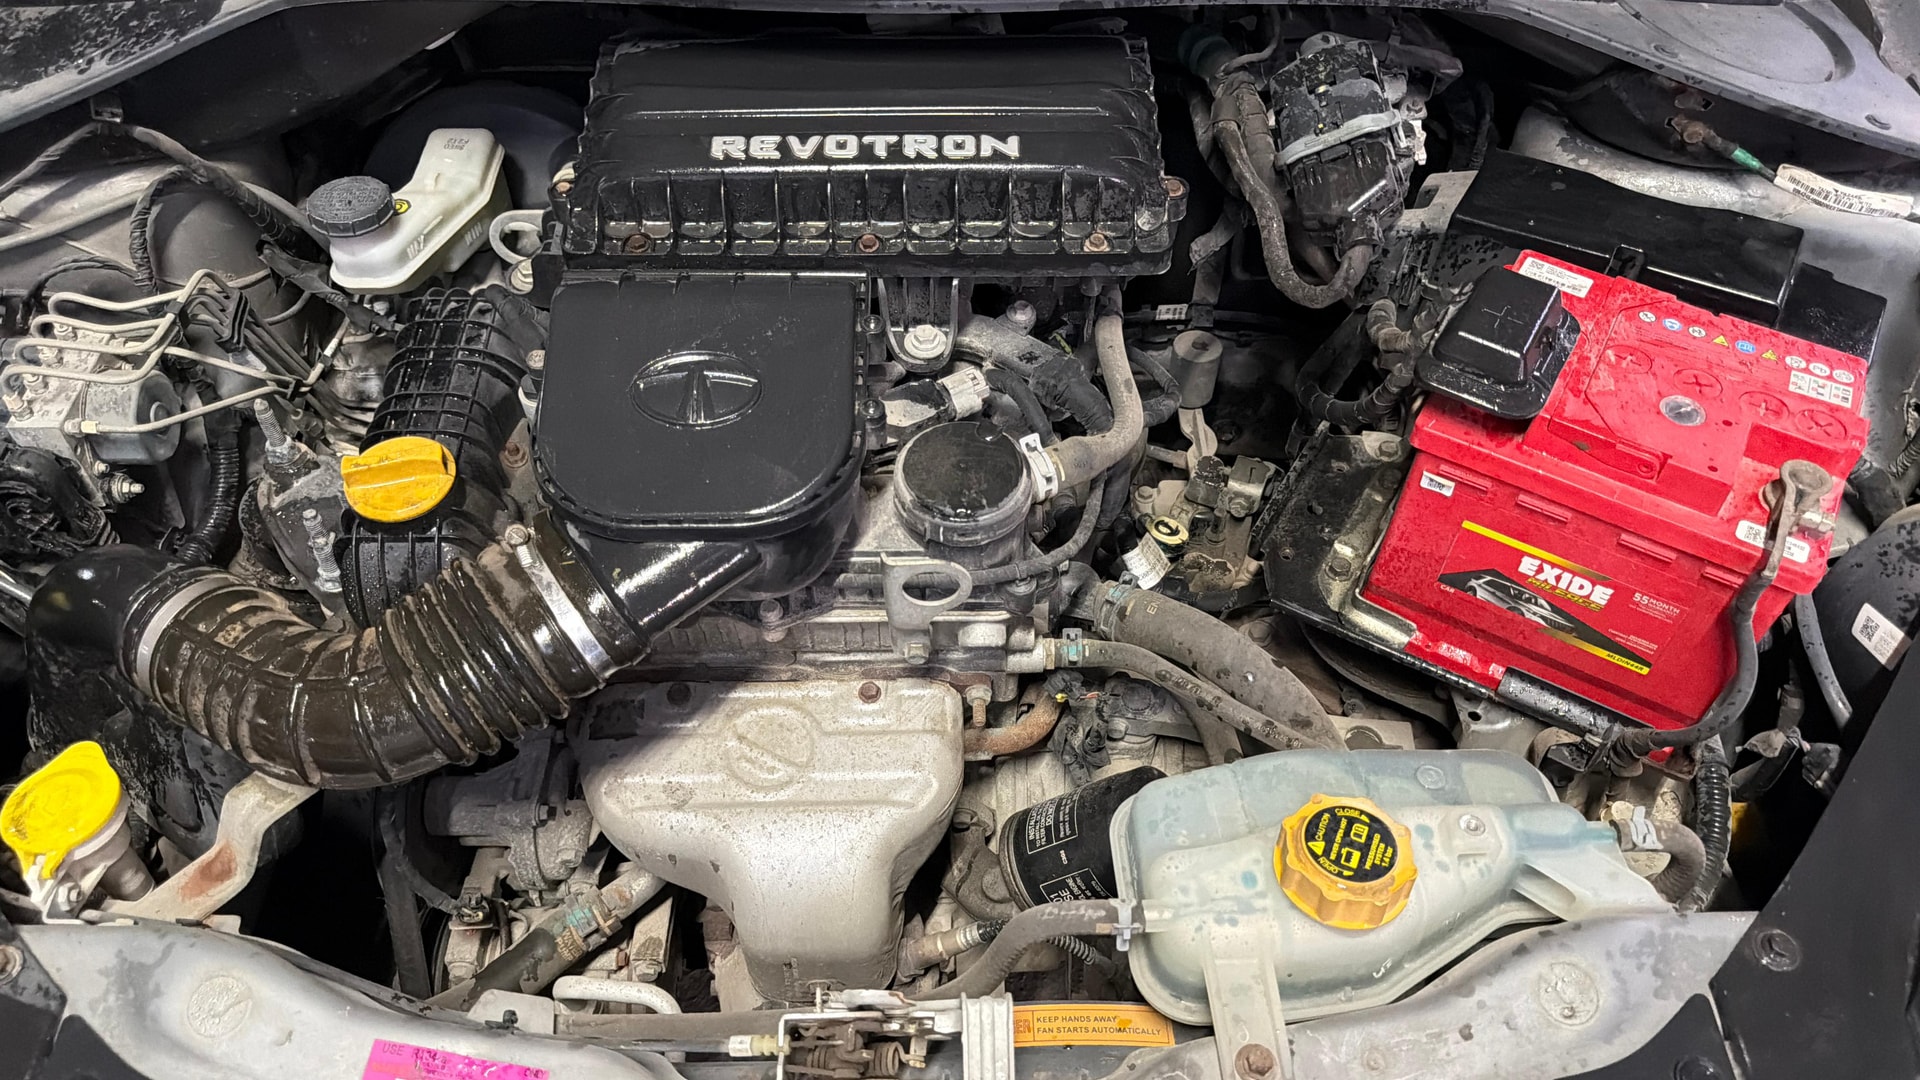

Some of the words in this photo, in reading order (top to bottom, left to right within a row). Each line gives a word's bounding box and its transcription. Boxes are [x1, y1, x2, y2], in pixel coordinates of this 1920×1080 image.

[710, 134, 1020, 160] REVOTRON
[464, 222, 483, 247] MIN
[1518, 555, 1615, 606] EXIDE
[1632, 592, 1650, 605] 55
[1649, 598, 1681, 615] MONTH
[1605, 652, 1644, 672] MLDIN44R
[1334, 807, 1361, 818] CLOSE
[1315, 812, 1331, 841] CAUTION
[1374, 842, 1386, 865] SYSTEM
[1384, 845, 1393, 857] bar
[1320, 856, 1338, 874] OPEN
[1381, 856, 1390, 867] 1.4
[1036, 1015, 1059, 1024] KEEP
[1061, 1015, 1092, 1023] HANDS
[1093, 1015, 1118, 1023] AWAY
[1036, 1026, 1054, 1034] FAN
[1056, 1026, 1090, 1034] STARTS
[1091, 1026, 1161, 1036] AUTOMATICALLY
[382, 1043, 405, 1057] USE
